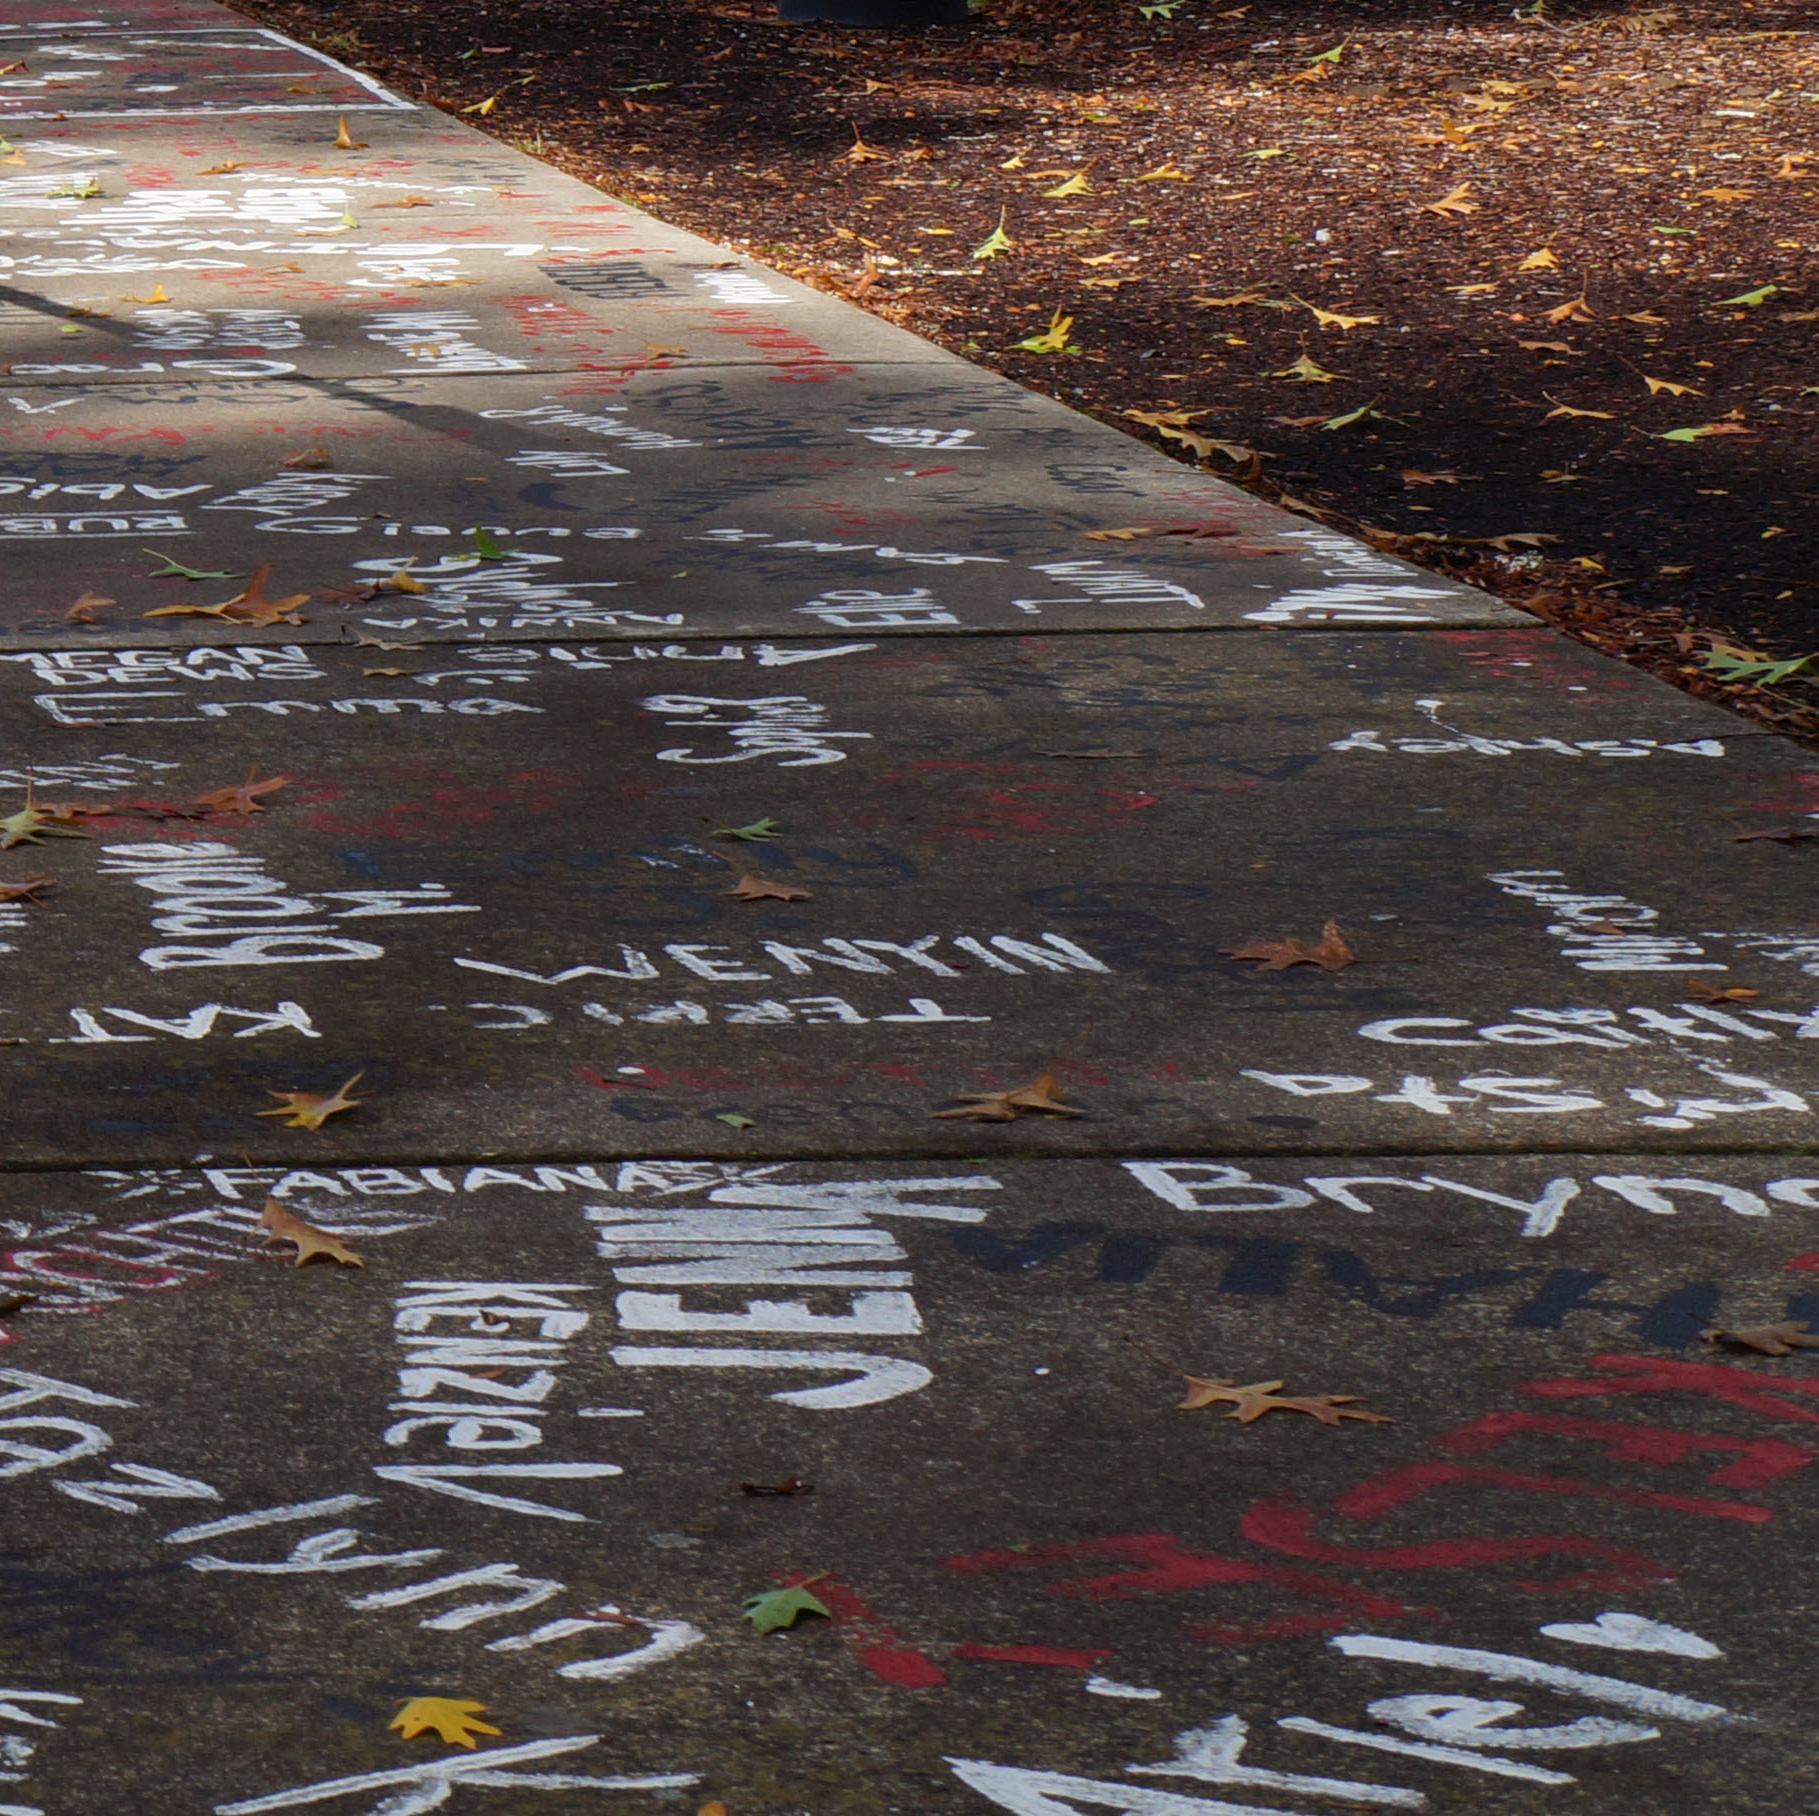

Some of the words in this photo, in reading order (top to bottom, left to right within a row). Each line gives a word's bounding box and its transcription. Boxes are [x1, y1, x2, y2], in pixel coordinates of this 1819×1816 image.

[251, 515, 645, 540] Gianna
[33, 661, 331, 687] DEWS
[457, 642, 881, 672] Annie
[31, 690, 549, 726] Emma
[97, 839, 387, 976] Brooke
[451, 932, 1111, 988] WENYIN
[203, 1162, 673, 1202] FABIANA
[581, 1176, 1007, 1414] JENNA
